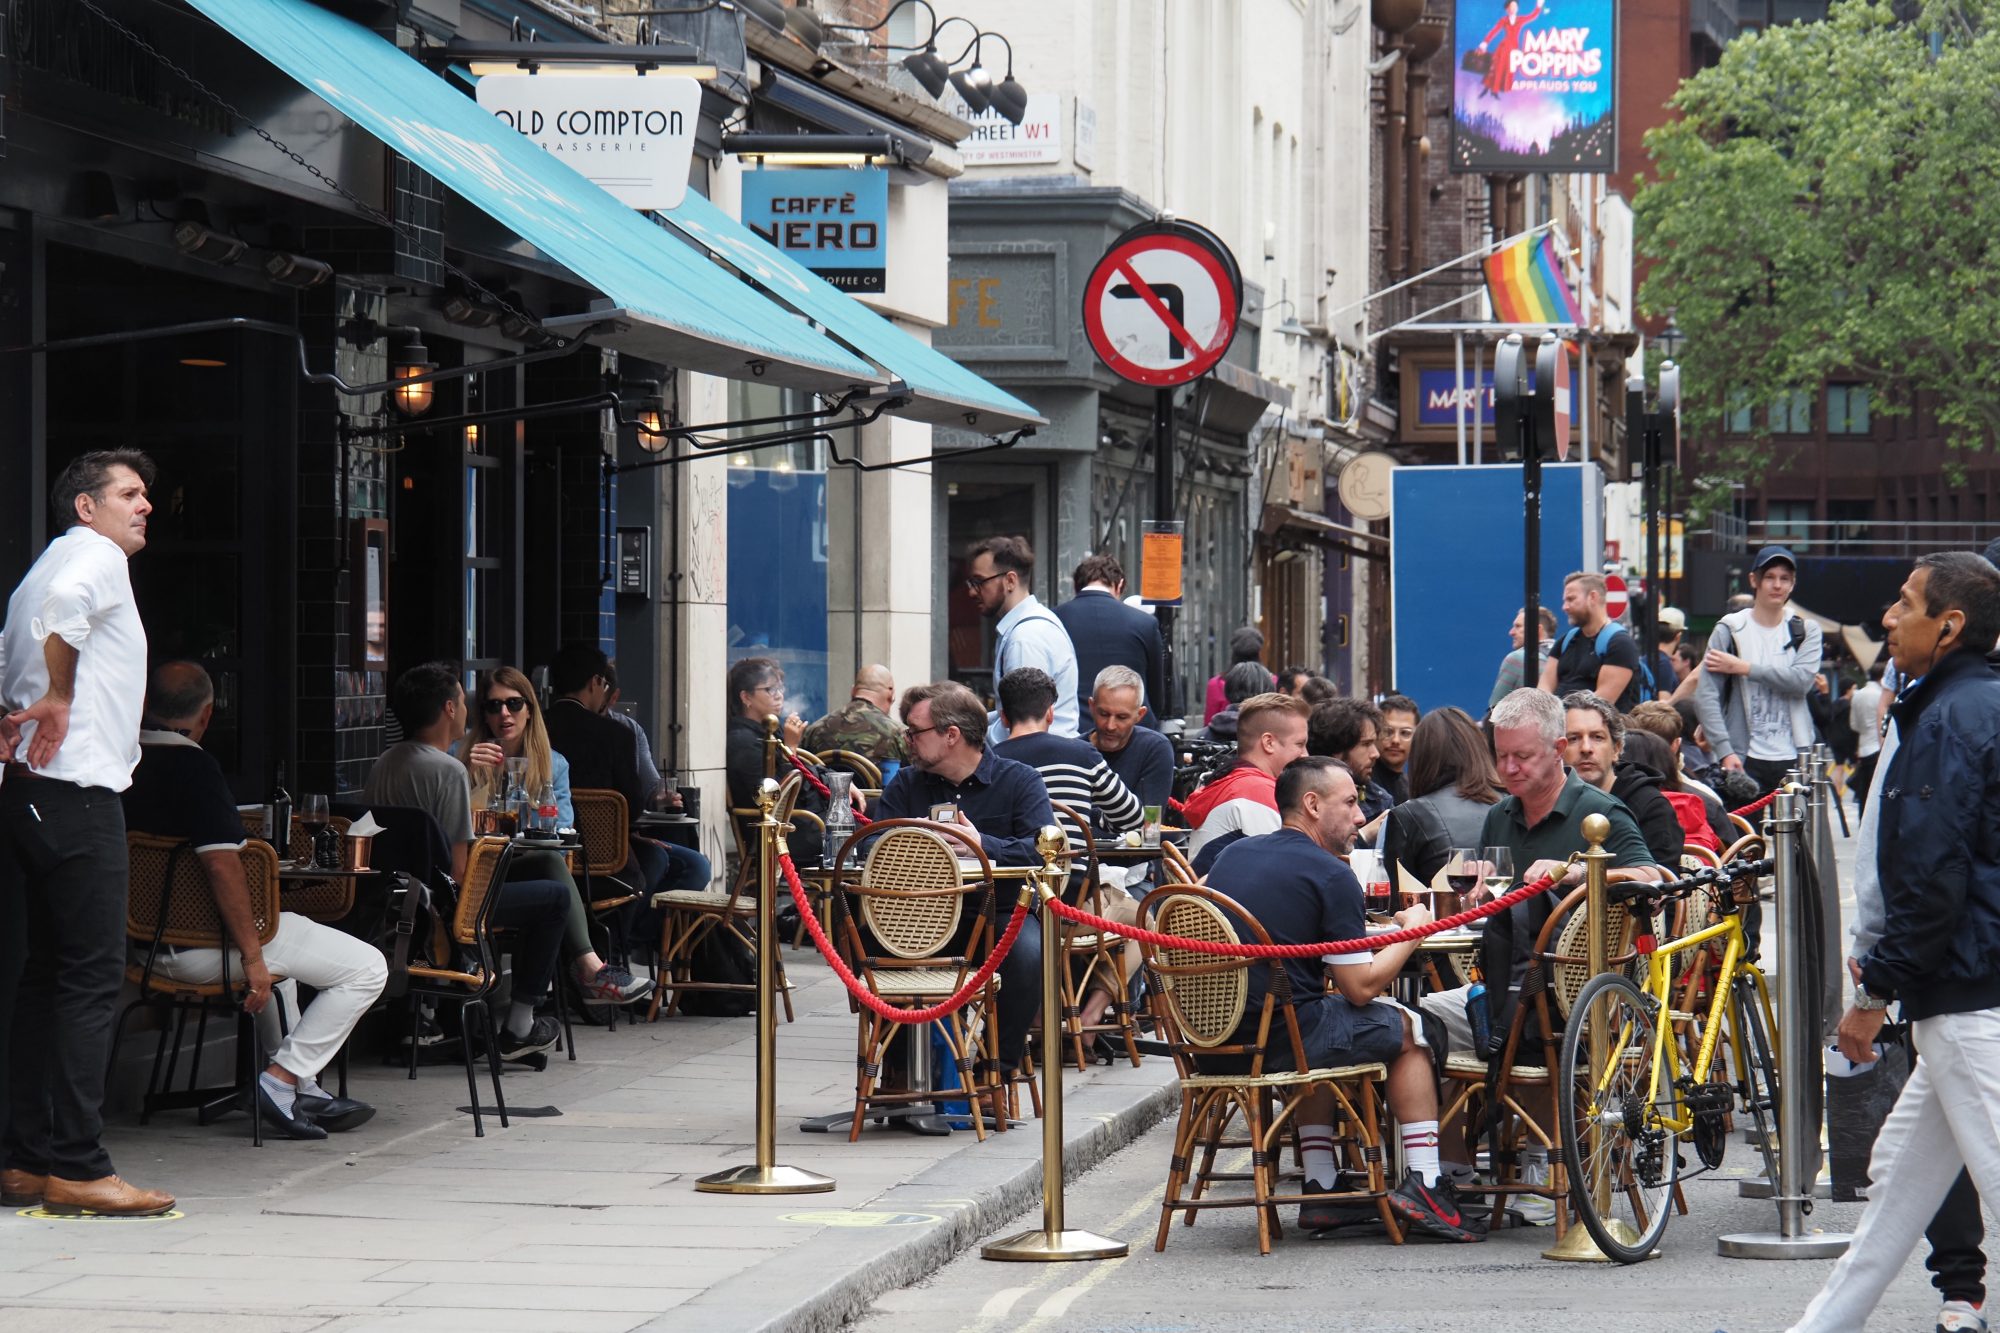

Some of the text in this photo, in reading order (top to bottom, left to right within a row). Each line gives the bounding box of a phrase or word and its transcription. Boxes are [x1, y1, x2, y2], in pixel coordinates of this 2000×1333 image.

[1524, 27, 1590, 53] MARY
[1509, 49, 1602, 77] POPPINS
[1511, 80, 1597, 92] APPLAUDS YOU
[556, 110, 683, 135] COMPTON
[970, 123, 1049, 141] REET W1
[542, 142, 647, 152] RASSERIE
[771, 192, 856, 213] CAFFÈ
[823, 276, 858, 285] OFFEE
[949, 278, 1002, 329] FE
